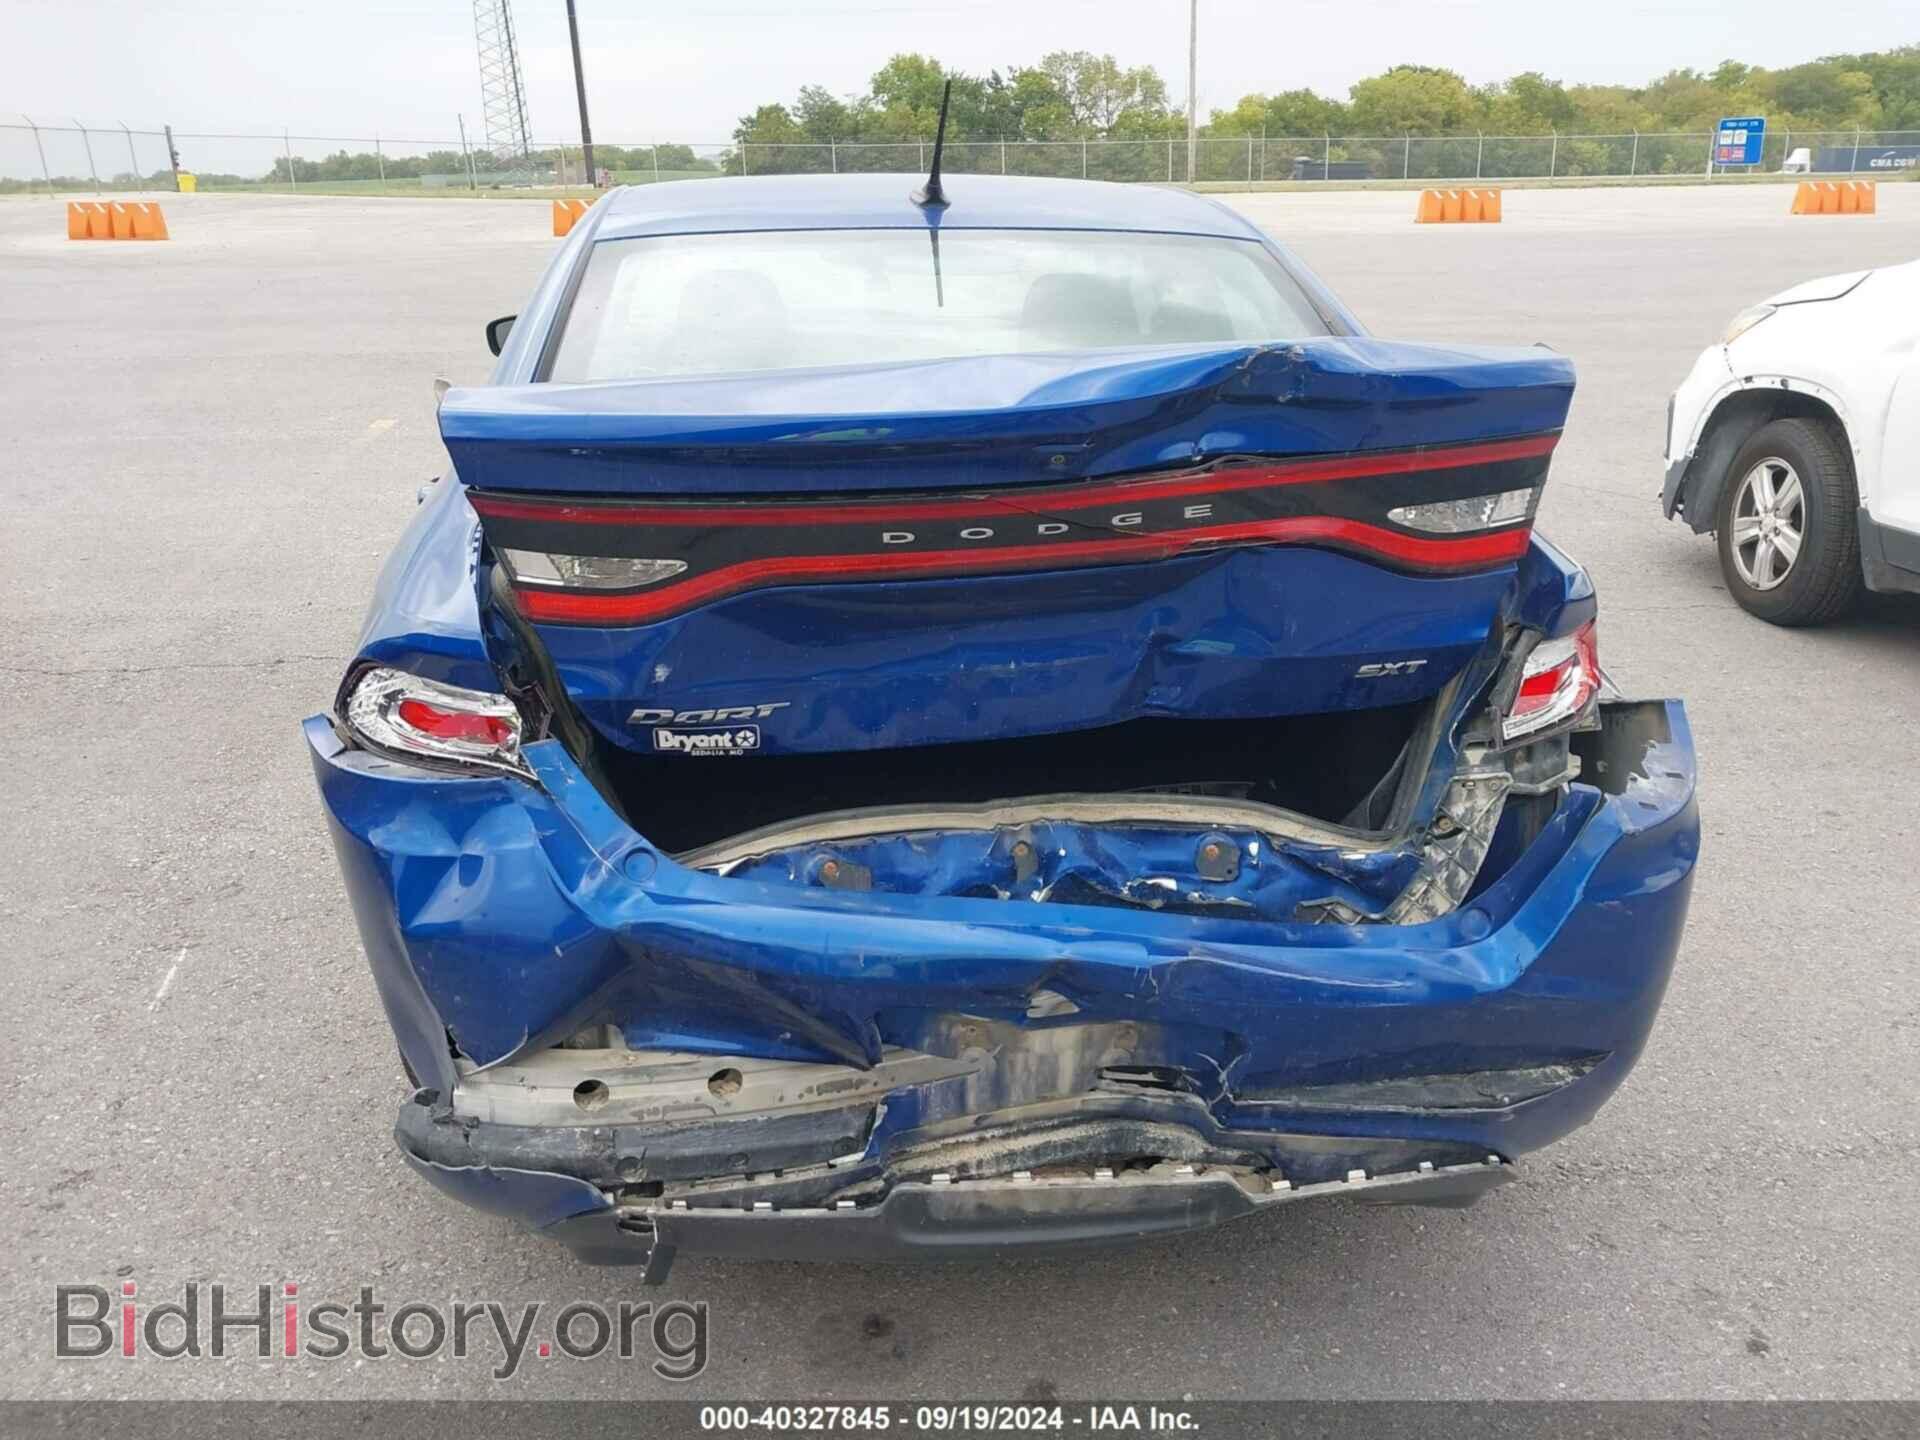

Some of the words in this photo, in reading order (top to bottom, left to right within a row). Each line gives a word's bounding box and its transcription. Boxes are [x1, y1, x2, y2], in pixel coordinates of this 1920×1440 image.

[882, 503, 1213, 544] DODGE
[1354, 659, 1428, 679] SXT
[657, 729, 734, 752] Bryant
